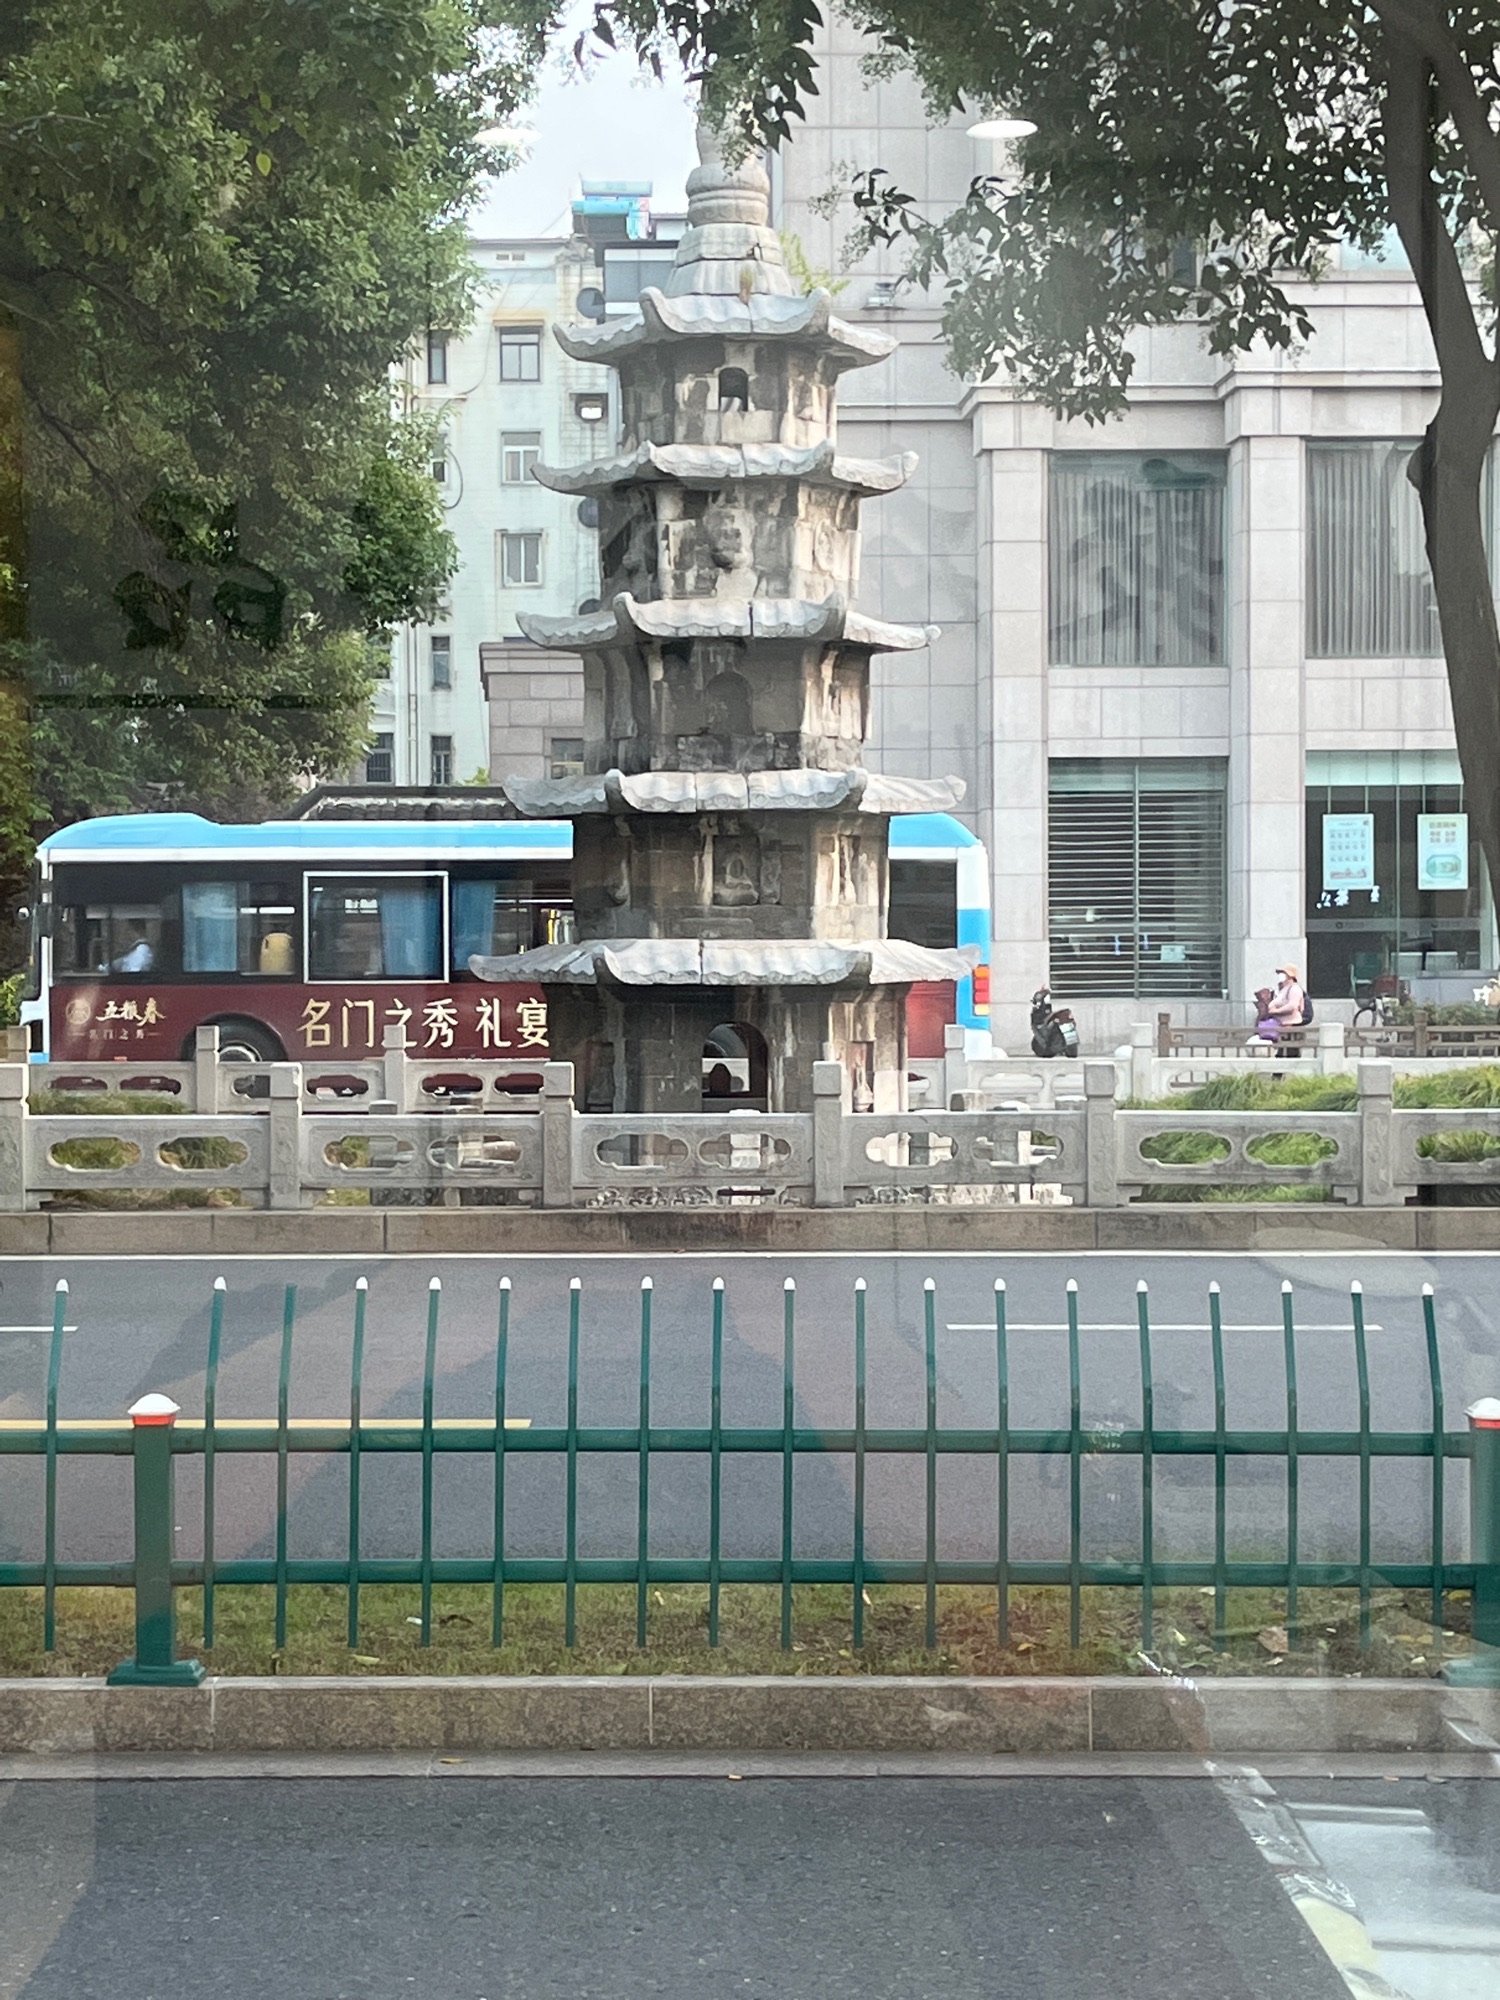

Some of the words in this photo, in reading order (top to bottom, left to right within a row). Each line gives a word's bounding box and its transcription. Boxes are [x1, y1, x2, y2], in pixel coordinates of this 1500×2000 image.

[297, 998, 459, 1048] 名门之秀
[475, 997, 549, 1048] 礼宴
